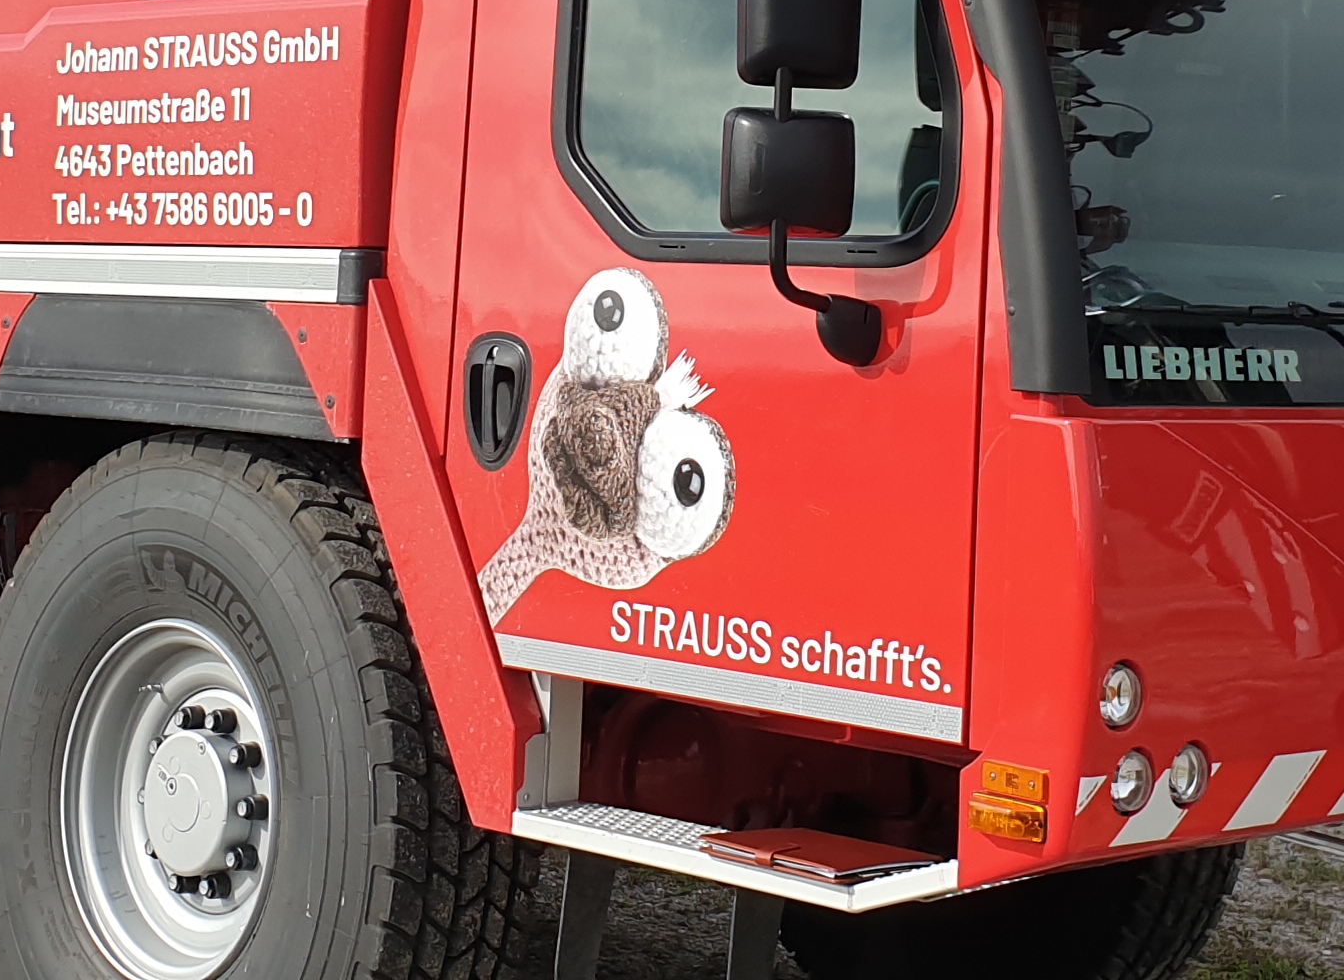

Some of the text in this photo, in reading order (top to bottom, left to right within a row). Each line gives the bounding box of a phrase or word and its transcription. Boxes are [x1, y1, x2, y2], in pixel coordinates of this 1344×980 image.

[56, 26, 340, 74] Johann STRAUSS GmbH
[56, 86, 251, 127] Museumstraße 11
[54, 141, 254, 177] 4643 Pettenbach
[52, 192, 101, 225] Tel.:
[105, 192, 148, 225] +43
[152, 191, 208, 226] 7586
[212, 191, 274, 227] 6005
[296, 191, 313, 227] 0
[1103, 345, 1302, 382] LIEBHERR
[610, 600, 772, 665] STRAUSS
